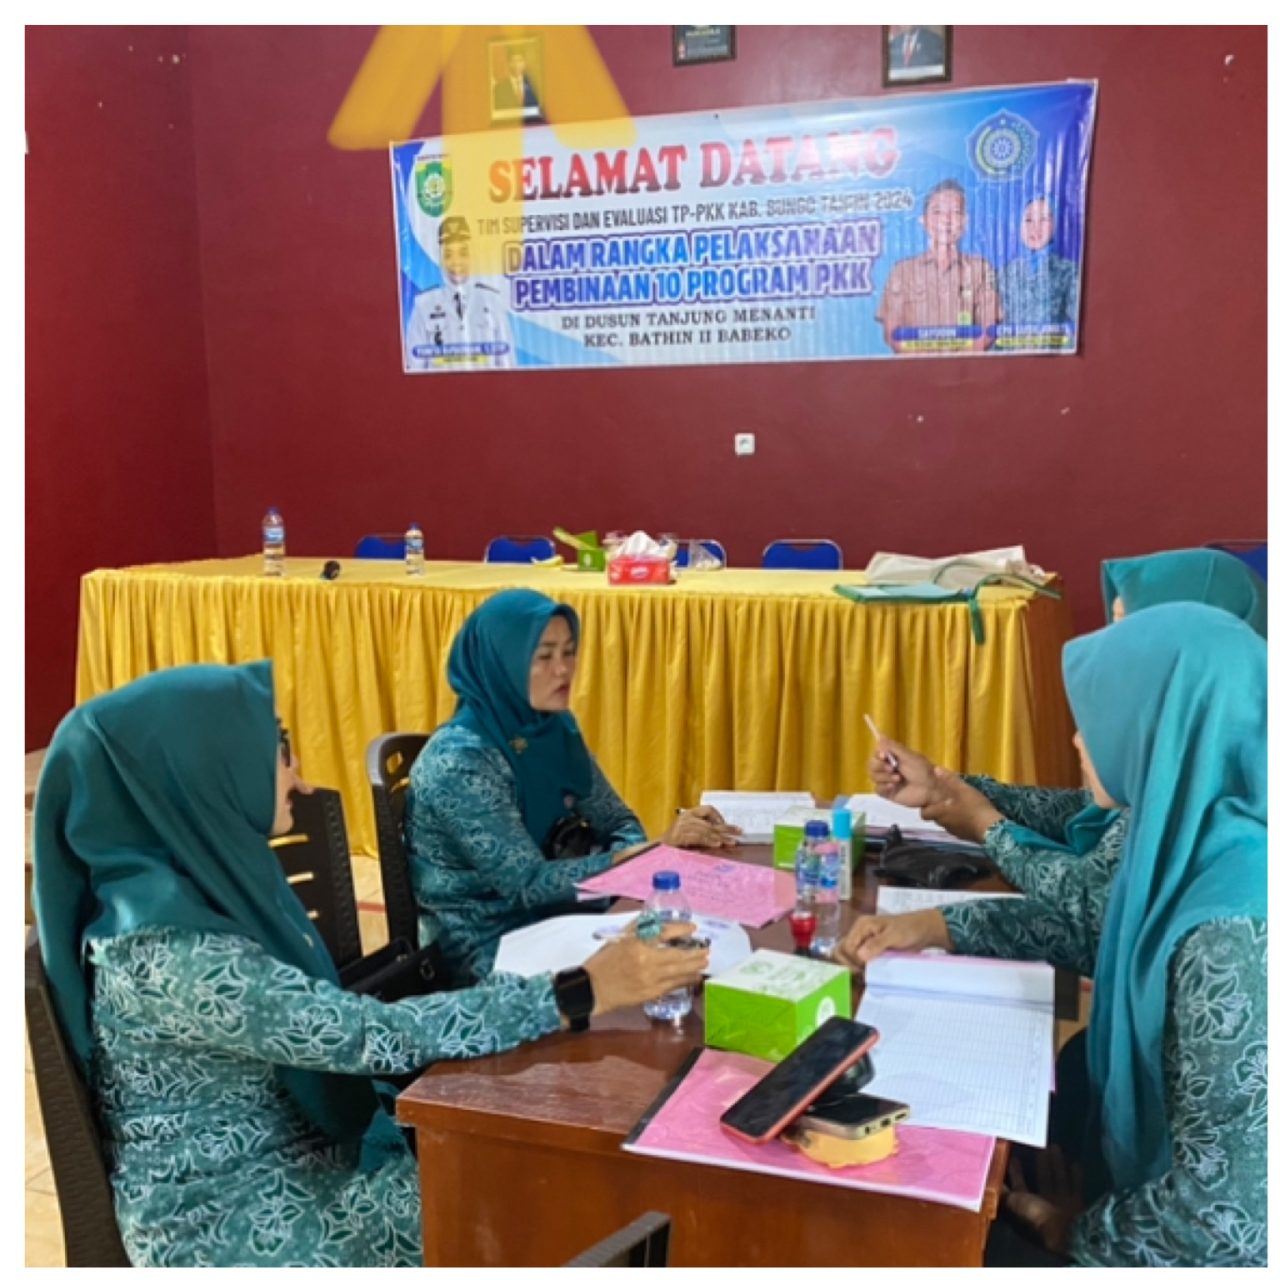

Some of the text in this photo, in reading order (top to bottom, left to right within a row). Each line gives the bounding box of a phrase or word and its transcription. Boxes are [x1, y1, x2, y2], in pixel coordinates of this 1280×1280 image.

[489, 128, 898, 203] SELAMAT DATANG
[477, 217, 500, 235] TIM
[503, 212, 569, 235] SUPERVISI
[573, 210, 600, 230] DAN
[603, 206, 667, 228] EVALUASI
[671, 202, 725, 224] TP-PKK
[728, 200, 762, 220] KAB.
[508, 224, 876, 273] DALAM RANGKA PELAKSANAAN
[516, 262, 867, 304] PEMBINAAN 10 PROGRAM PKK
[561, 305, 816, 330] DI DUSUN TANJUNG MENANTI
[583, 327, 791, 347] KEC. BATHIN II BABEKO
